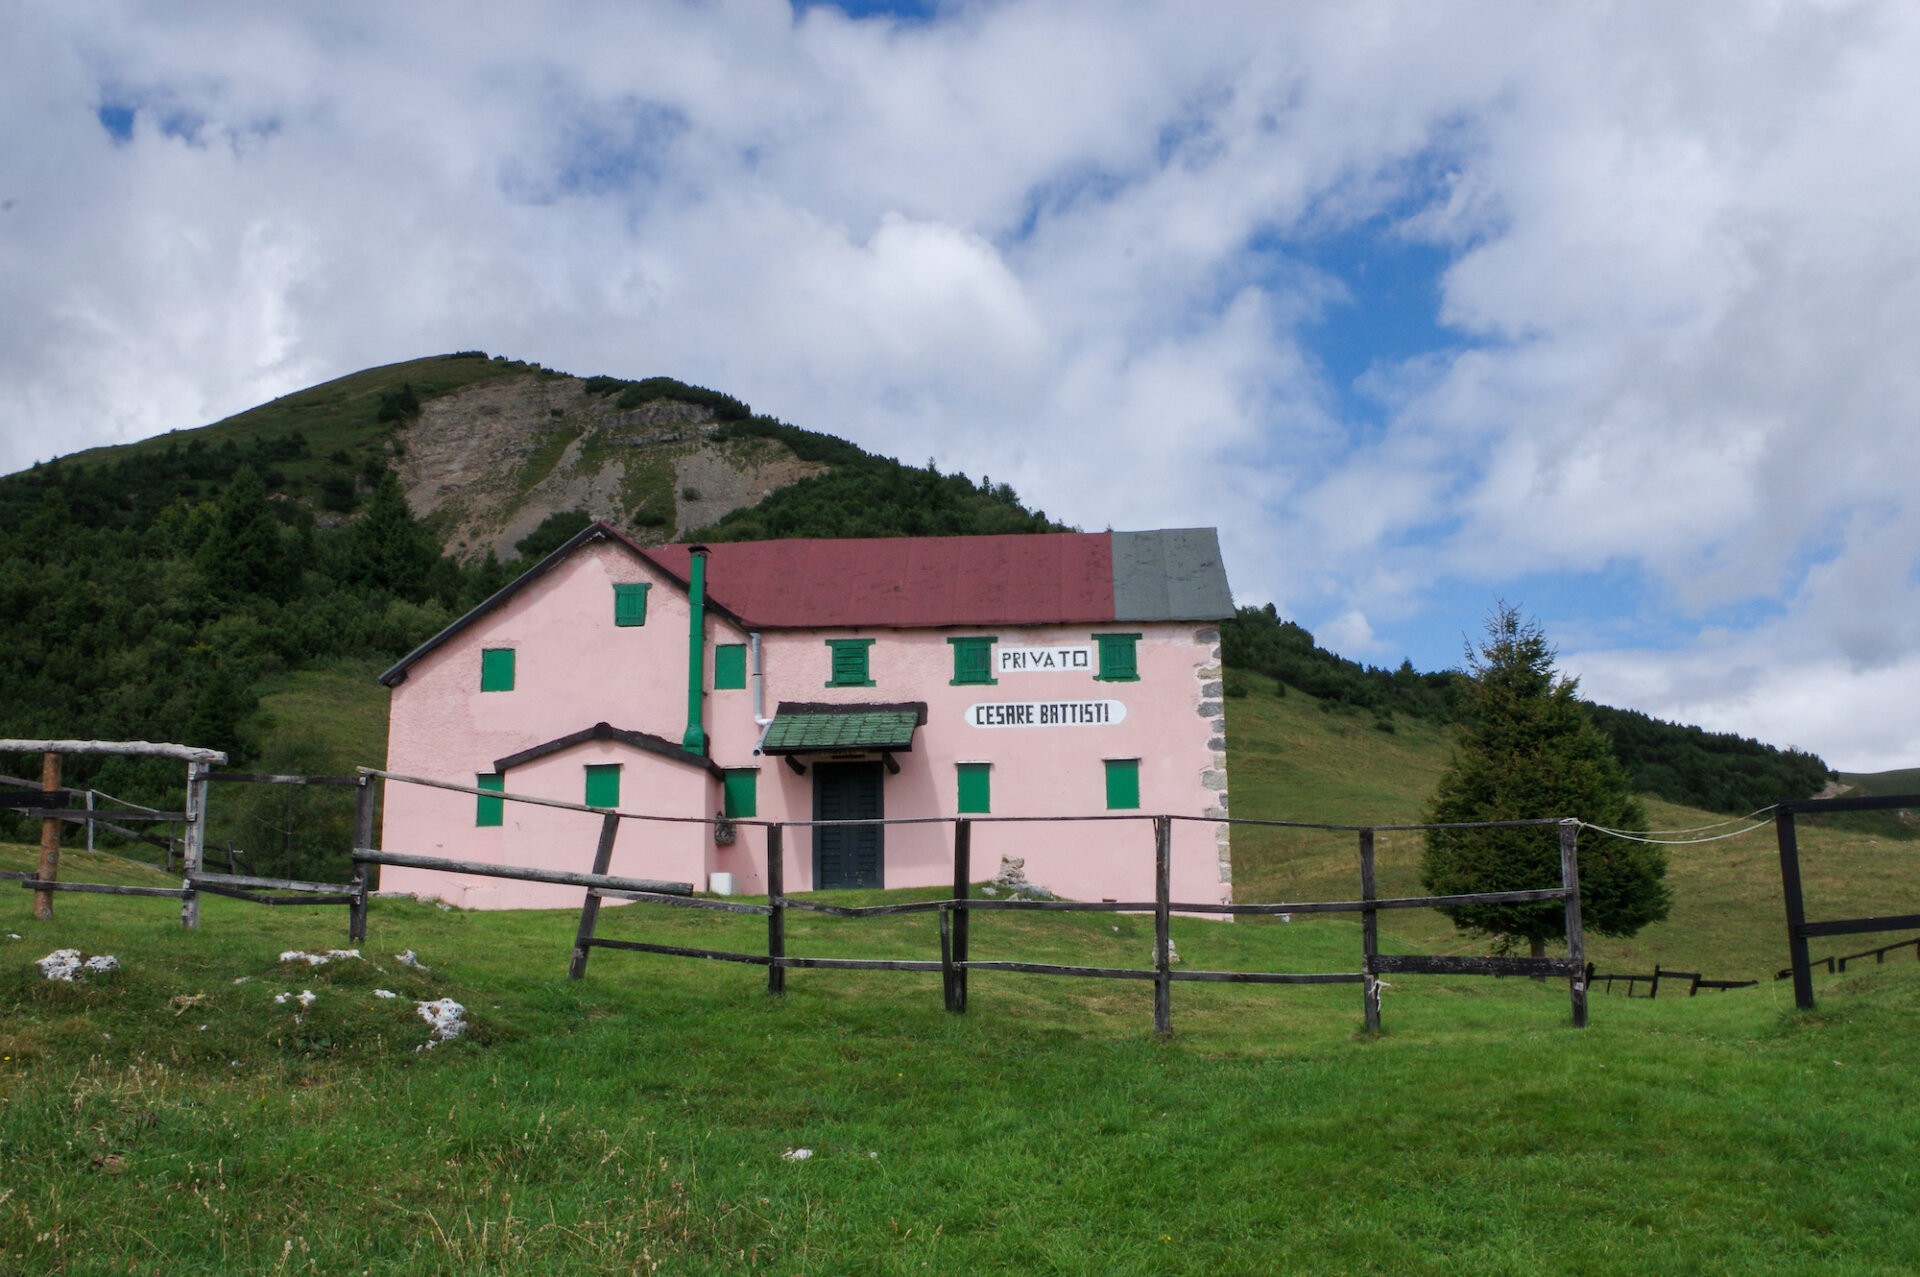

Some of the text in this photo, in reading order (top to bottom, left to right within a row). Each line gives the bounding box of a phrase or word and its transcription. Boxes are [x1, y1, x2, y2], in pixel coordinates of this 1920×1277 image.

[1002, 650, 1088, 669] PRIVATO
[976, 703, 1109, 725] CESARE BATTISTI
